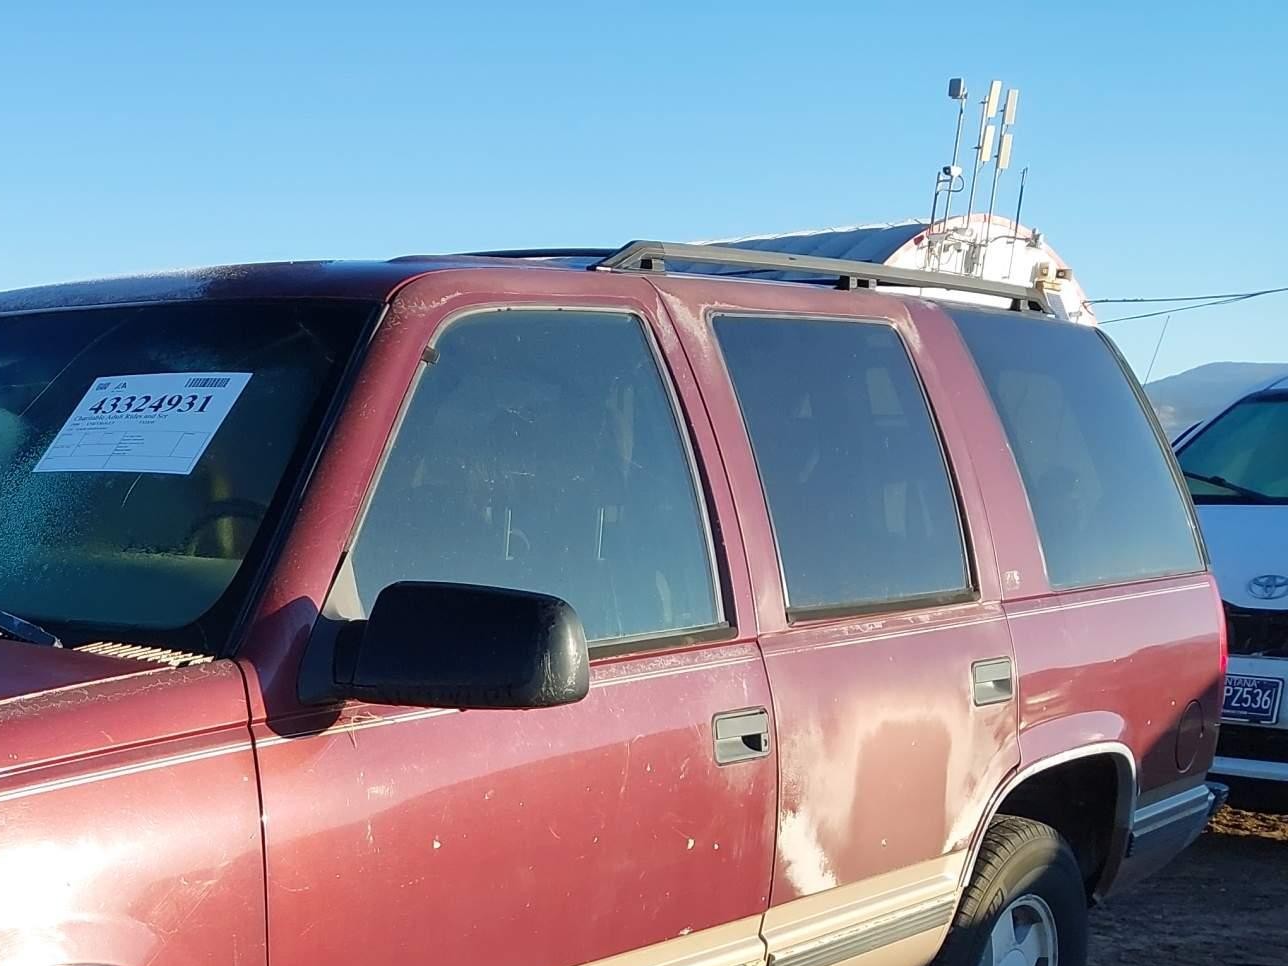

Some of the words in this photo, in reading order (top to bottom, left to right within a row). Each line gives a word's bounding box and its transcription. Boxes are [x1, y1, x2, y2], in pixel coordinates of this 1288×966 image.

[89, 394, 214, 414] 43324931
[1223, 678, 1258, 688] NTANA
[1223, 687, 1271, 709] PZ536
